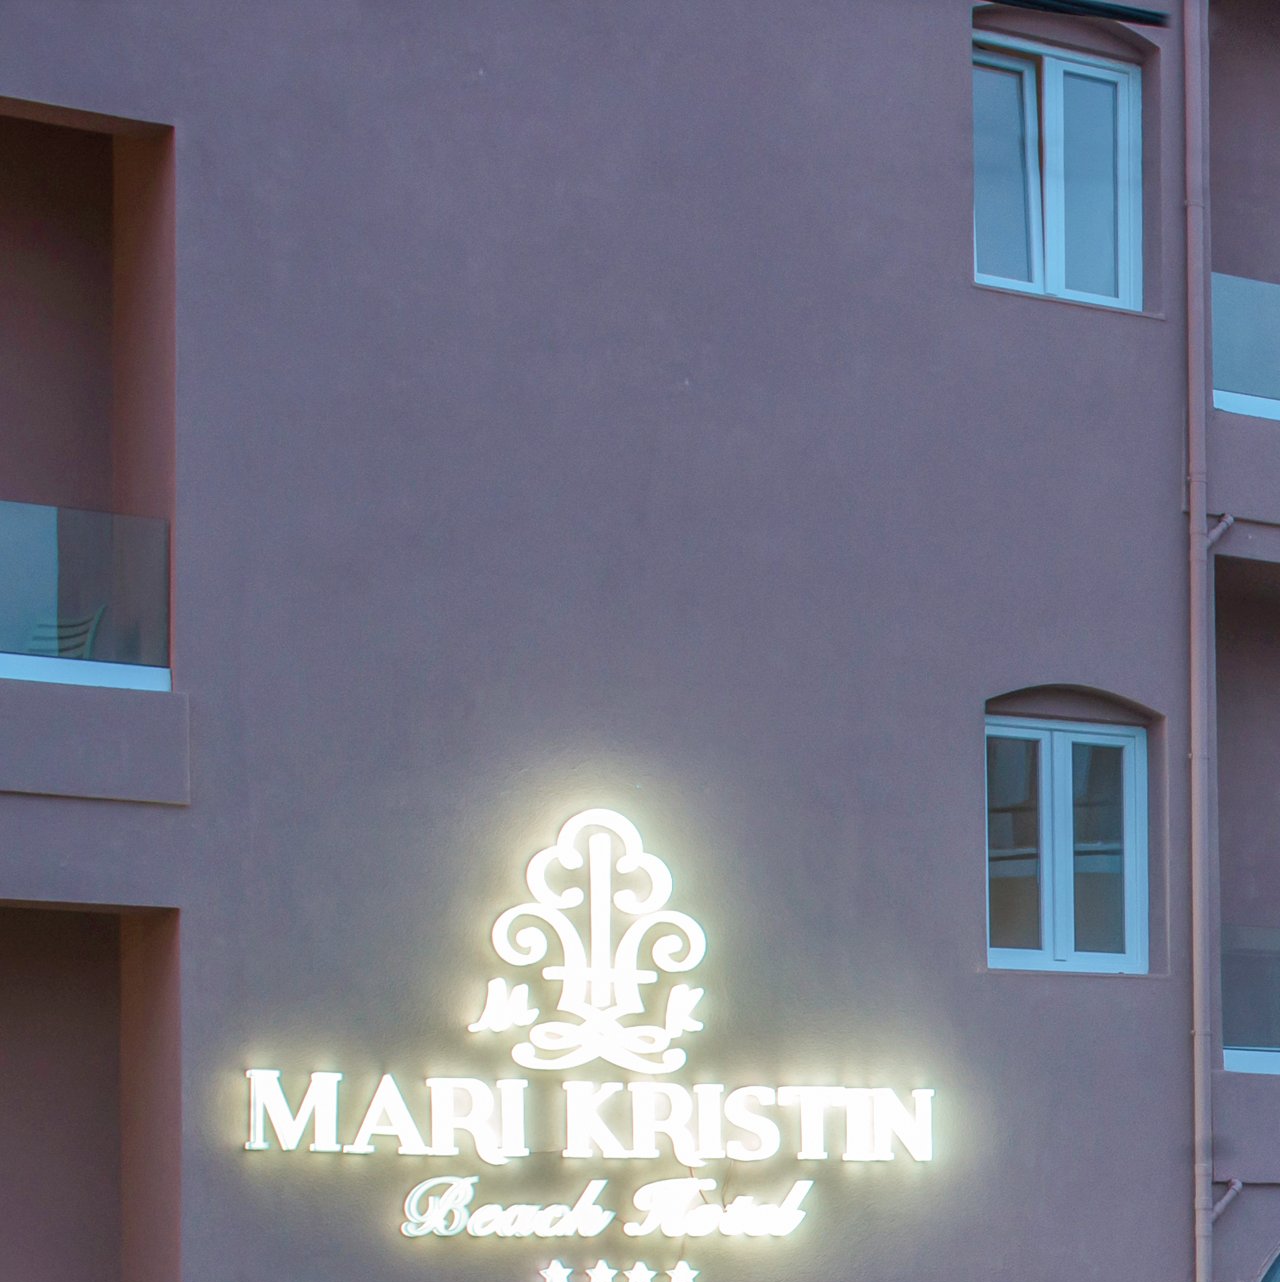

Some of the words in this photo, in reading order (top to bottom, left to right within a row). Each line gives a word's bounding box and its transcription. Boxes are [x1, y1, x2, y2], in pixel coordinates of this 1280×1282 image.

[244, 1069, 529, 1165] MARI
[562, 1081, 935, 1167] KRISTIN
[401, 1176, 617, 1237] Beach
